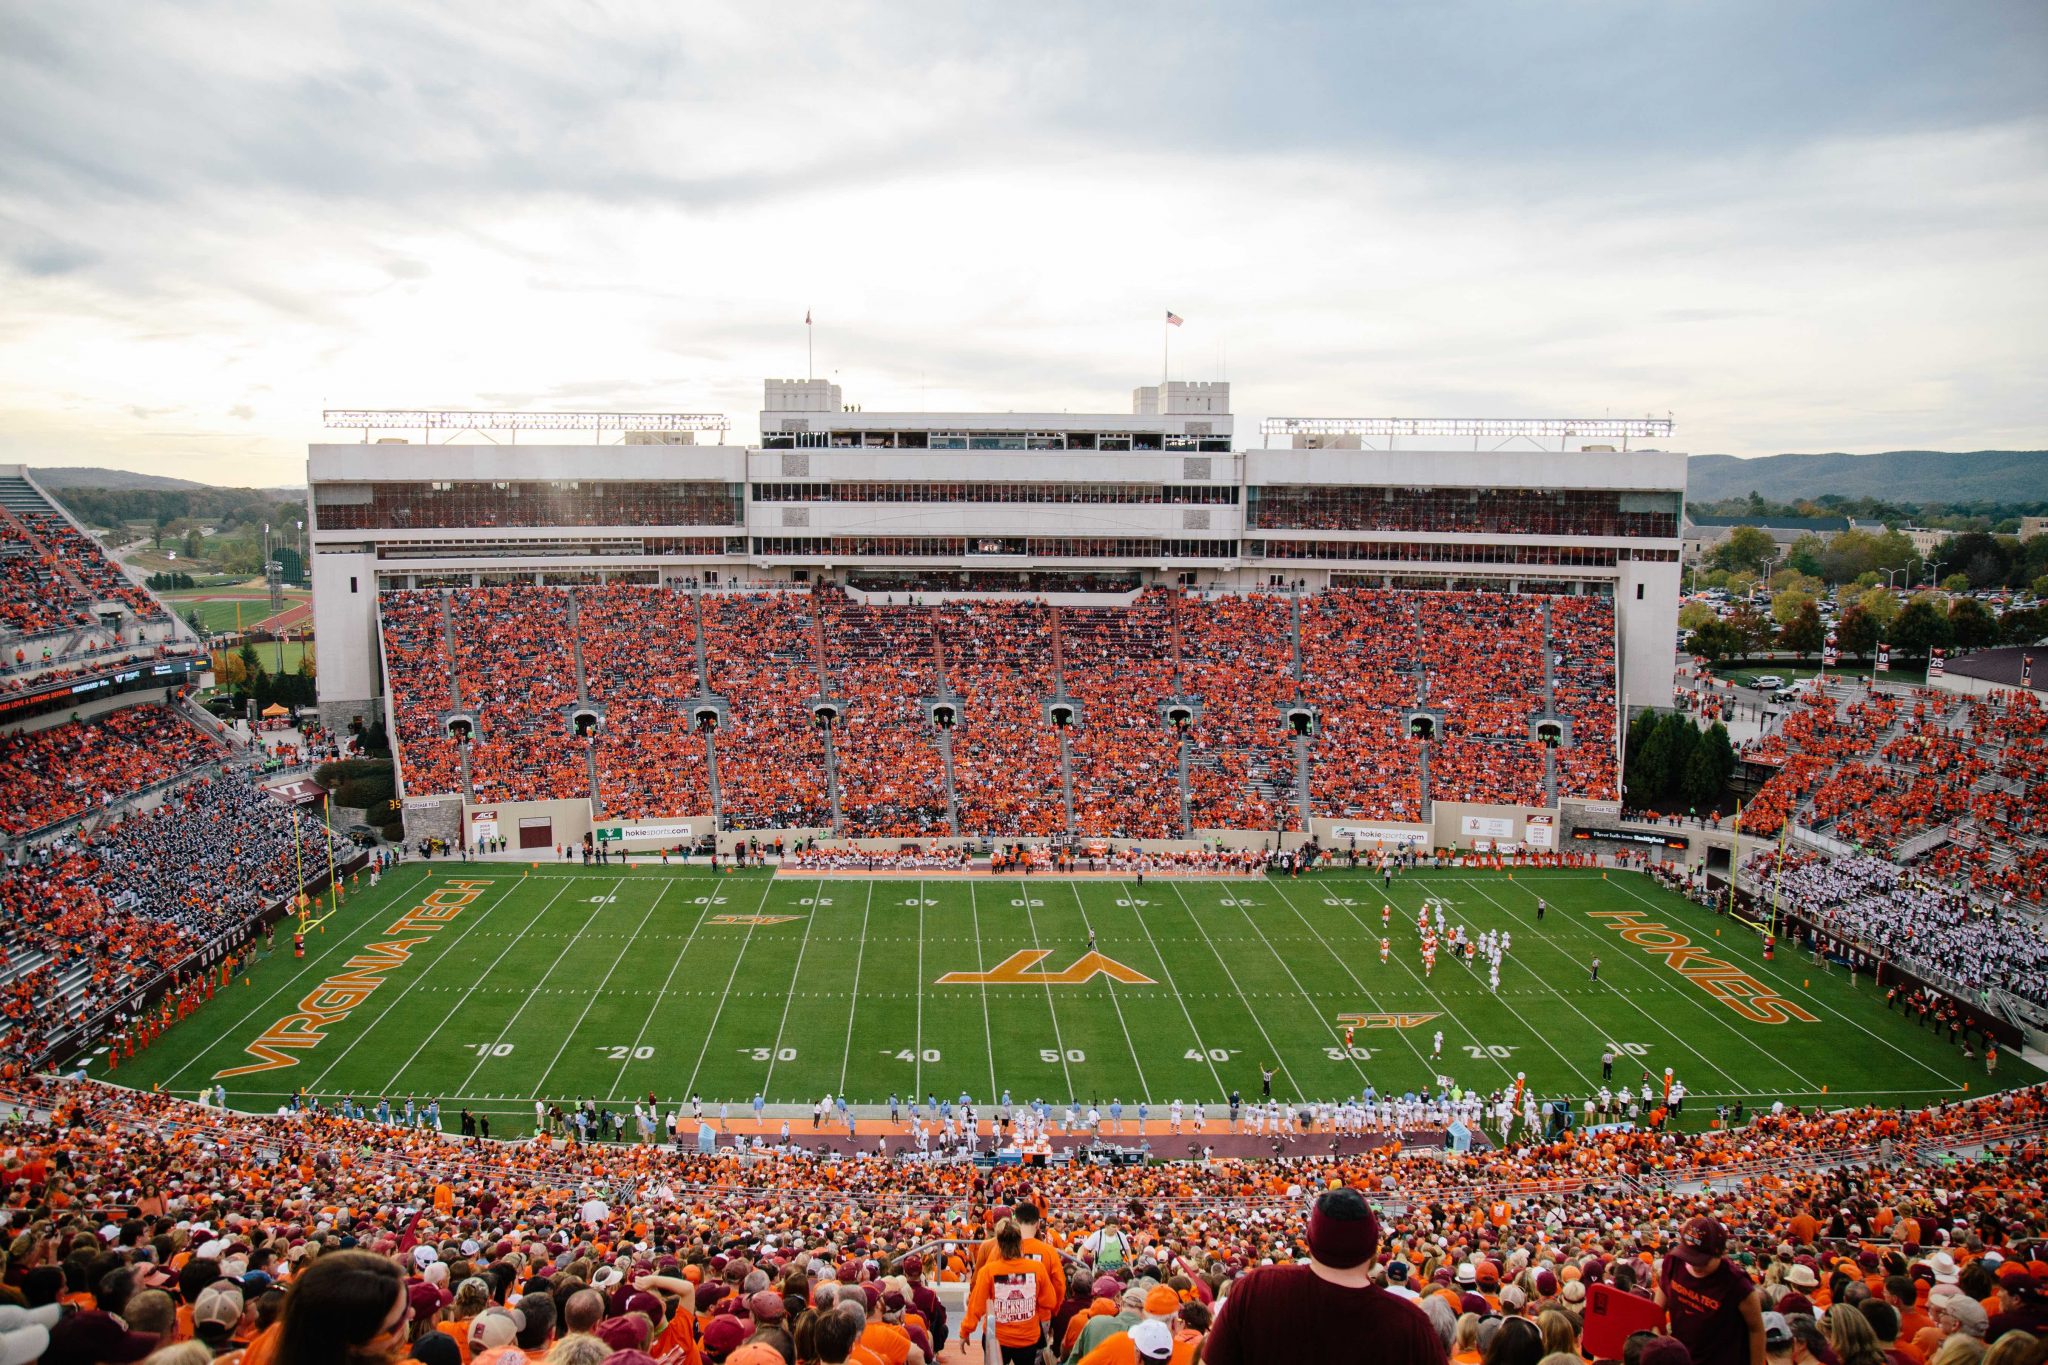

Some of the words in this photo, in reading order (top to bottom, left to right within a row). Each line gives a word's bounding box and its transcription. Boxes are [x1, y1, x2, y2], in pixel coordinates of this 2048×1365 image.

[1824, 646, 1836, 657] 84
[1878, 652, 1888, 663] 10
[1931, 657, 1944, 668] 25
[2025, 667, 2031, 678] 7
[11, 699, 24, 709] LOVE
[268, 781, 304, 796] VT
[389, 800, 401, 810] 35
[475, 811, 494, 820] ACC
[1530, 815, 1550, 823] ACC
[625, 827, 689, 837] hokiesports.com
[1360, 830, 1424, 840] hokiesports.com
[1633, 835, 1665, 844] Smithfield
[590, 895, 617, 903] 10
[694, 897, 728, 905] 20
[799, 898, 833, 906] 30
[905, 898, 939, 907] 40
[1011, 899, 1044, 907] 50
[1116, 899, 1149, 907] 40
[200, 929, 246, 967] HOKIES
[1584, 911, 1822, 1024] HOKIES
[211, 935, 433, 1080] VIRGINIA
[382, 879, 495, 935] TECH
[1923, 985, 1943, 1002] VT
[130, 992, 147, 1012] VT
[476, 1043, 515, 1056] 10
[607, 1046, 655, 1059] 20
[751, 1048, 797, 1061] 30
[1322, 1047, 1372, 1060] 30
[1462, 1045, 1521, 1059] 20
[1605, 1042, 1648, 1056] 10
[895, 1049, 941, 1062] 40
[1039, 1049, 1086, 1063] 50
[1183, 1048, 1230, 1062] 40
